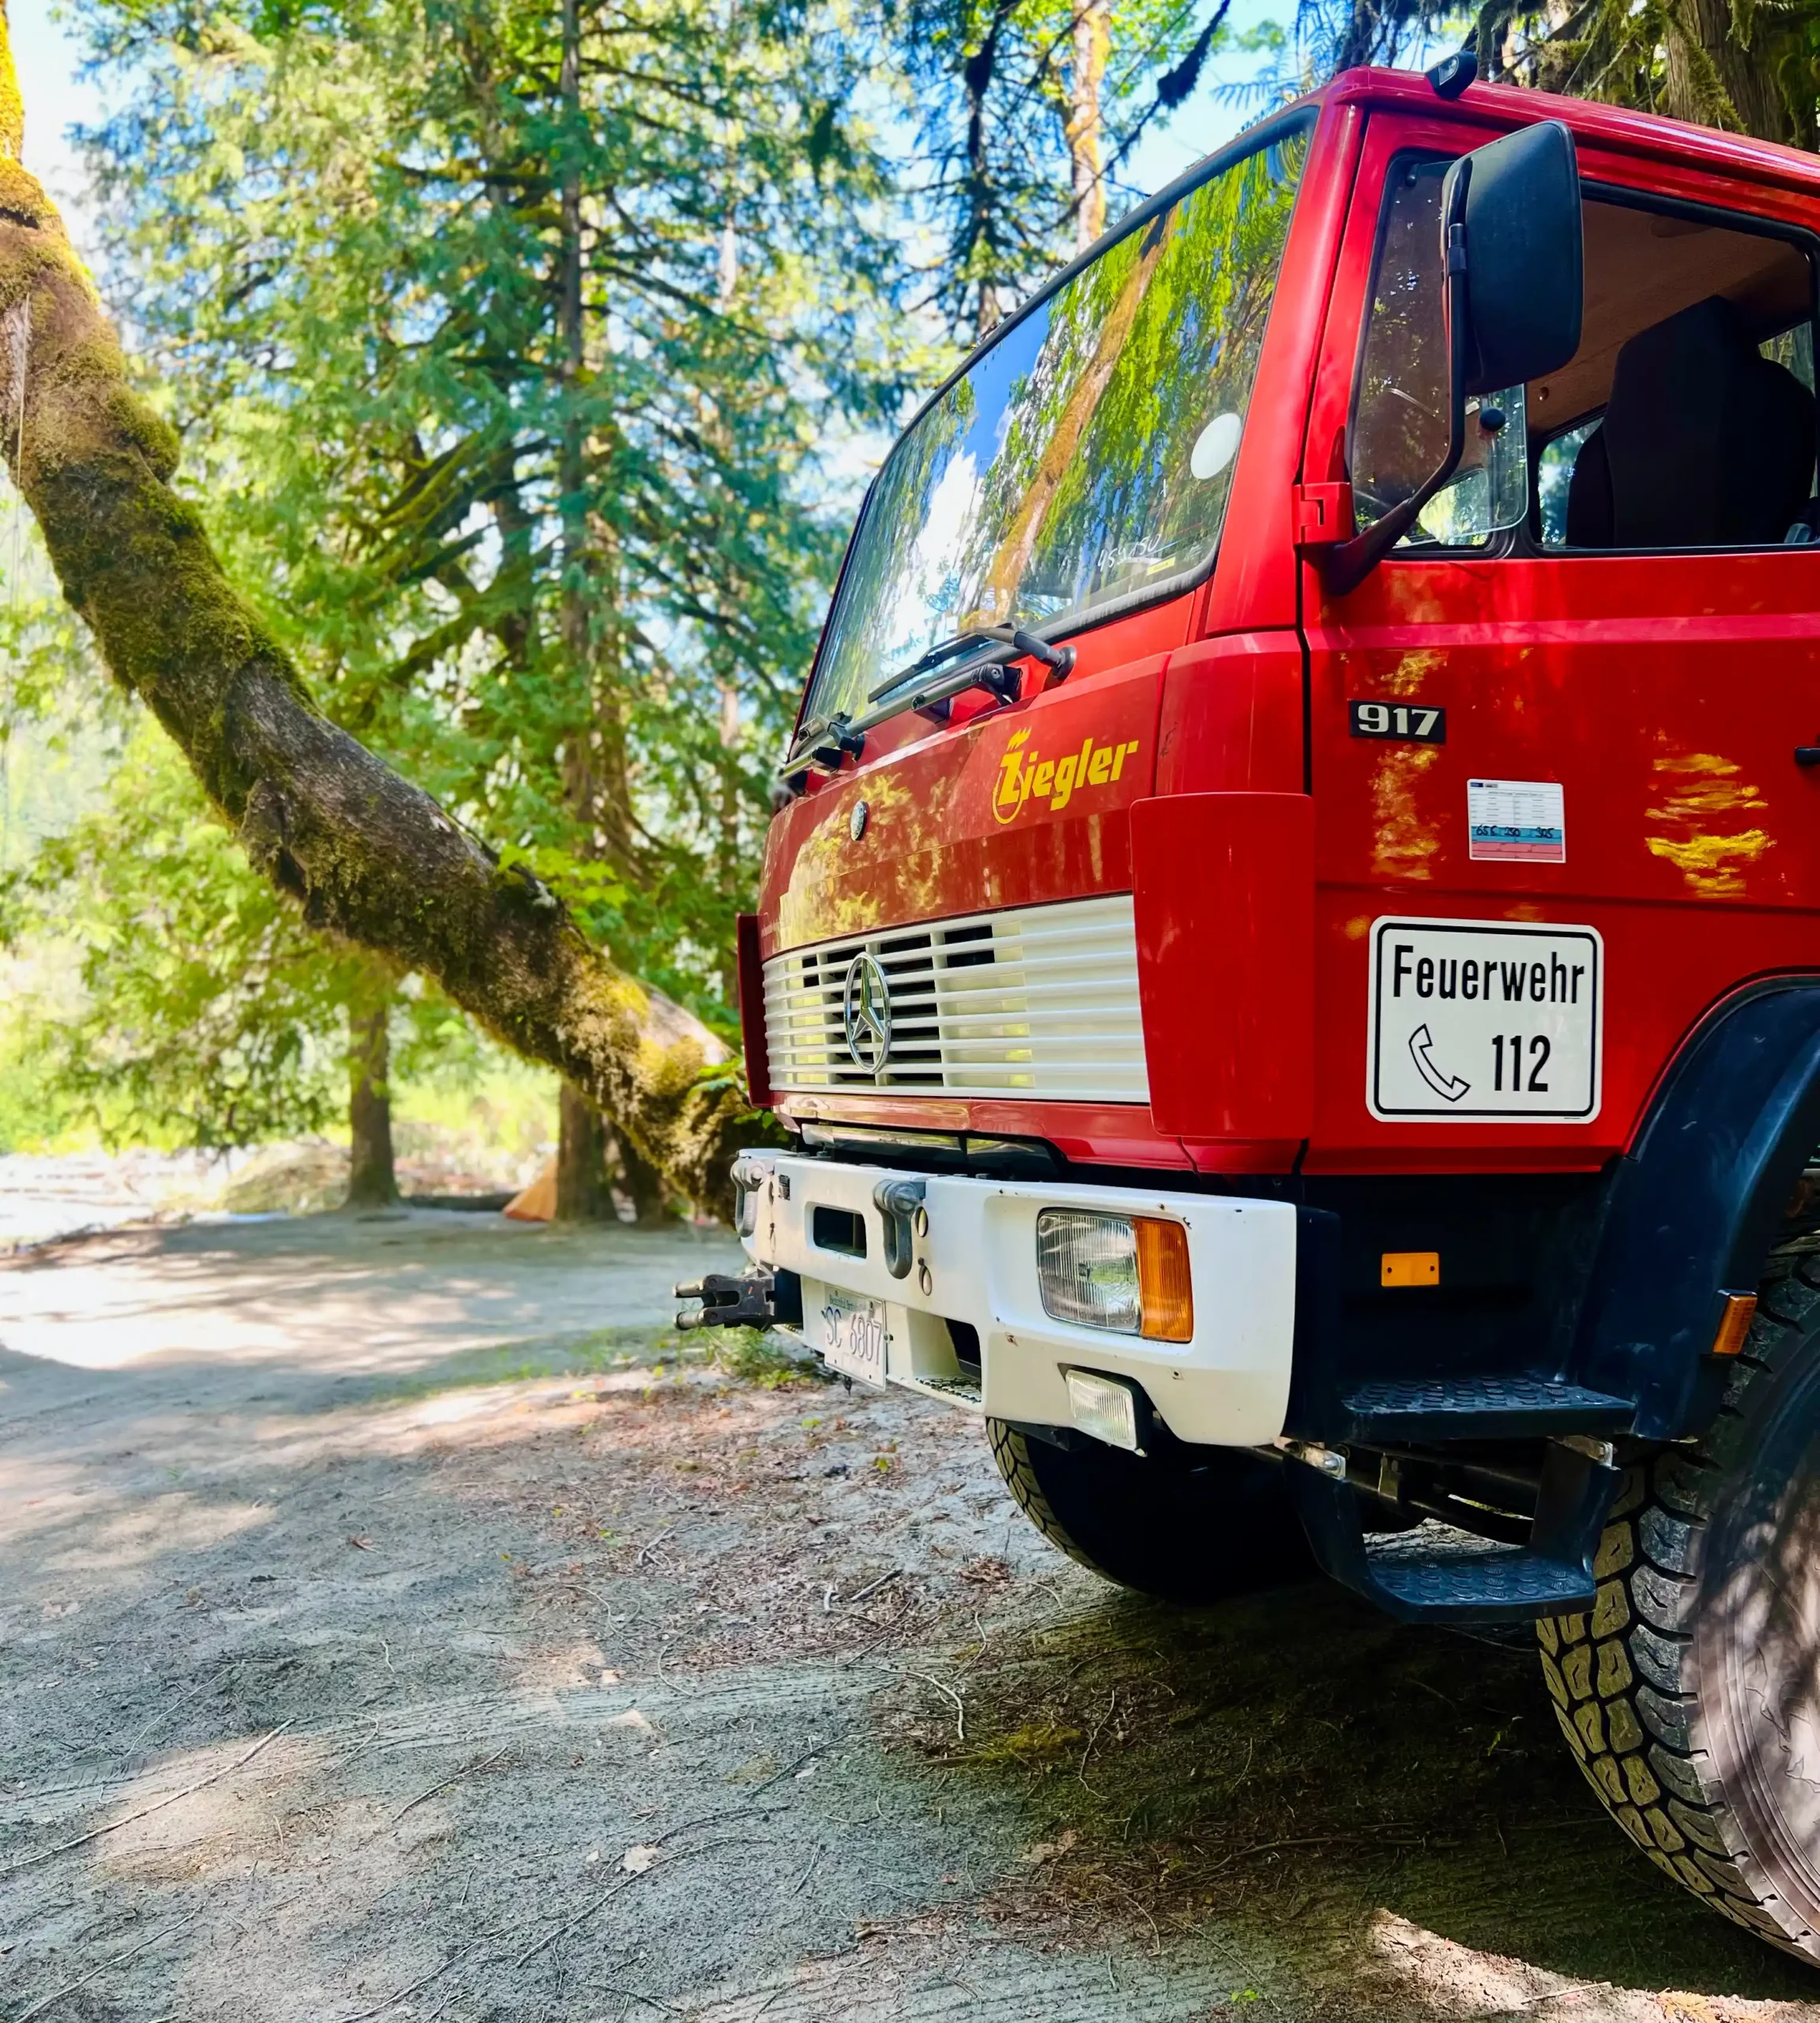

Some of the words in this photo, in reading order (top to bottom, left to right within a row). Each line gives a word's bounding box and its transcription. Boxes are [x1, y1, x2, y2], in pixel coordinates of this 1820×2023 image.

[1357, 703, 1440, 736] 917
[993, 736, 1139, 823] Ziegler
[1393, 944, 1584, 1004] Feuerwehr
[1492, 1034, 1551, 1092] 112
[826, 1305, 842, 1347] SC
[850, 1313, 881, 1366] 6807
